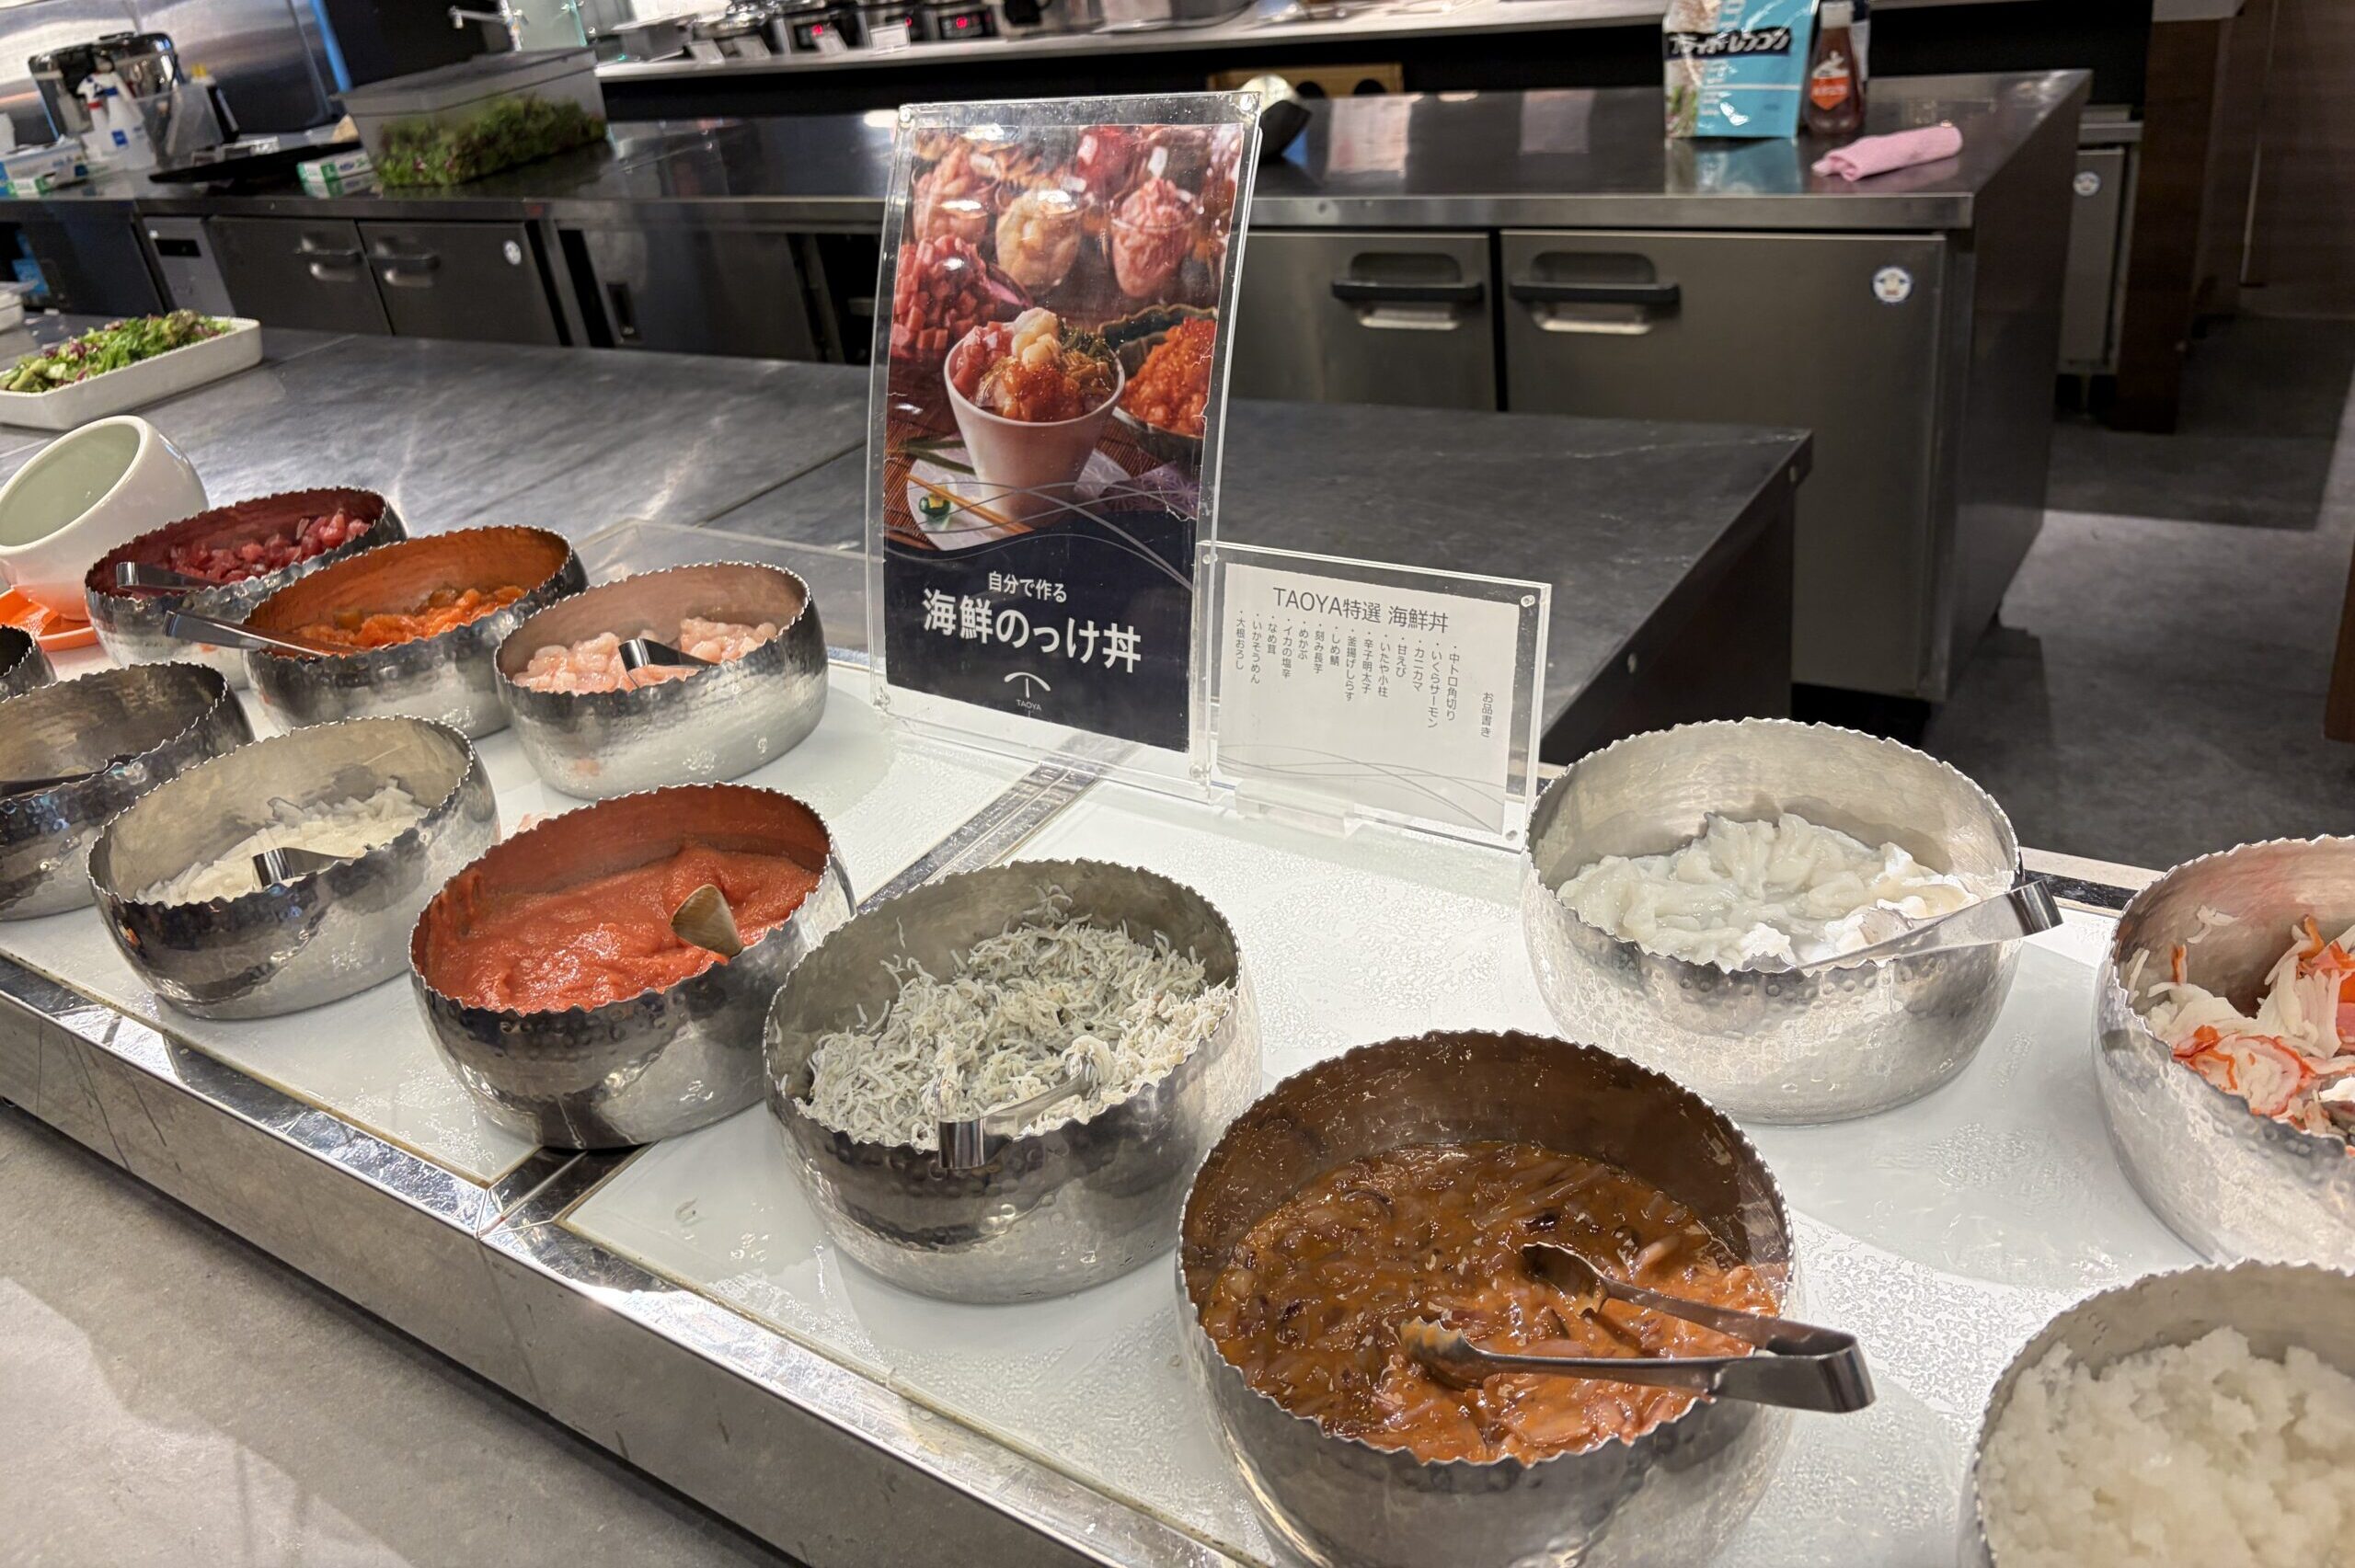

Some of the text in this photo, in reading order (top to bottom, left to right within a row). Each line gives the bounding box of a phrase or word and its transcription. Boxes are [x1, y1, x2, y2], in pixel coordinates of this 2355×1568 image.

[988, 570, 1067, 603] 自分で作る
[922, 588, 1142, 673] 海鮮のっけ丼
[1272, 586, 1449, 634] TAOYA特選 海鮮丼
[1016, 698, 1042, 712] TAOYA
[1479, 692, 1494, 738] お品書き
